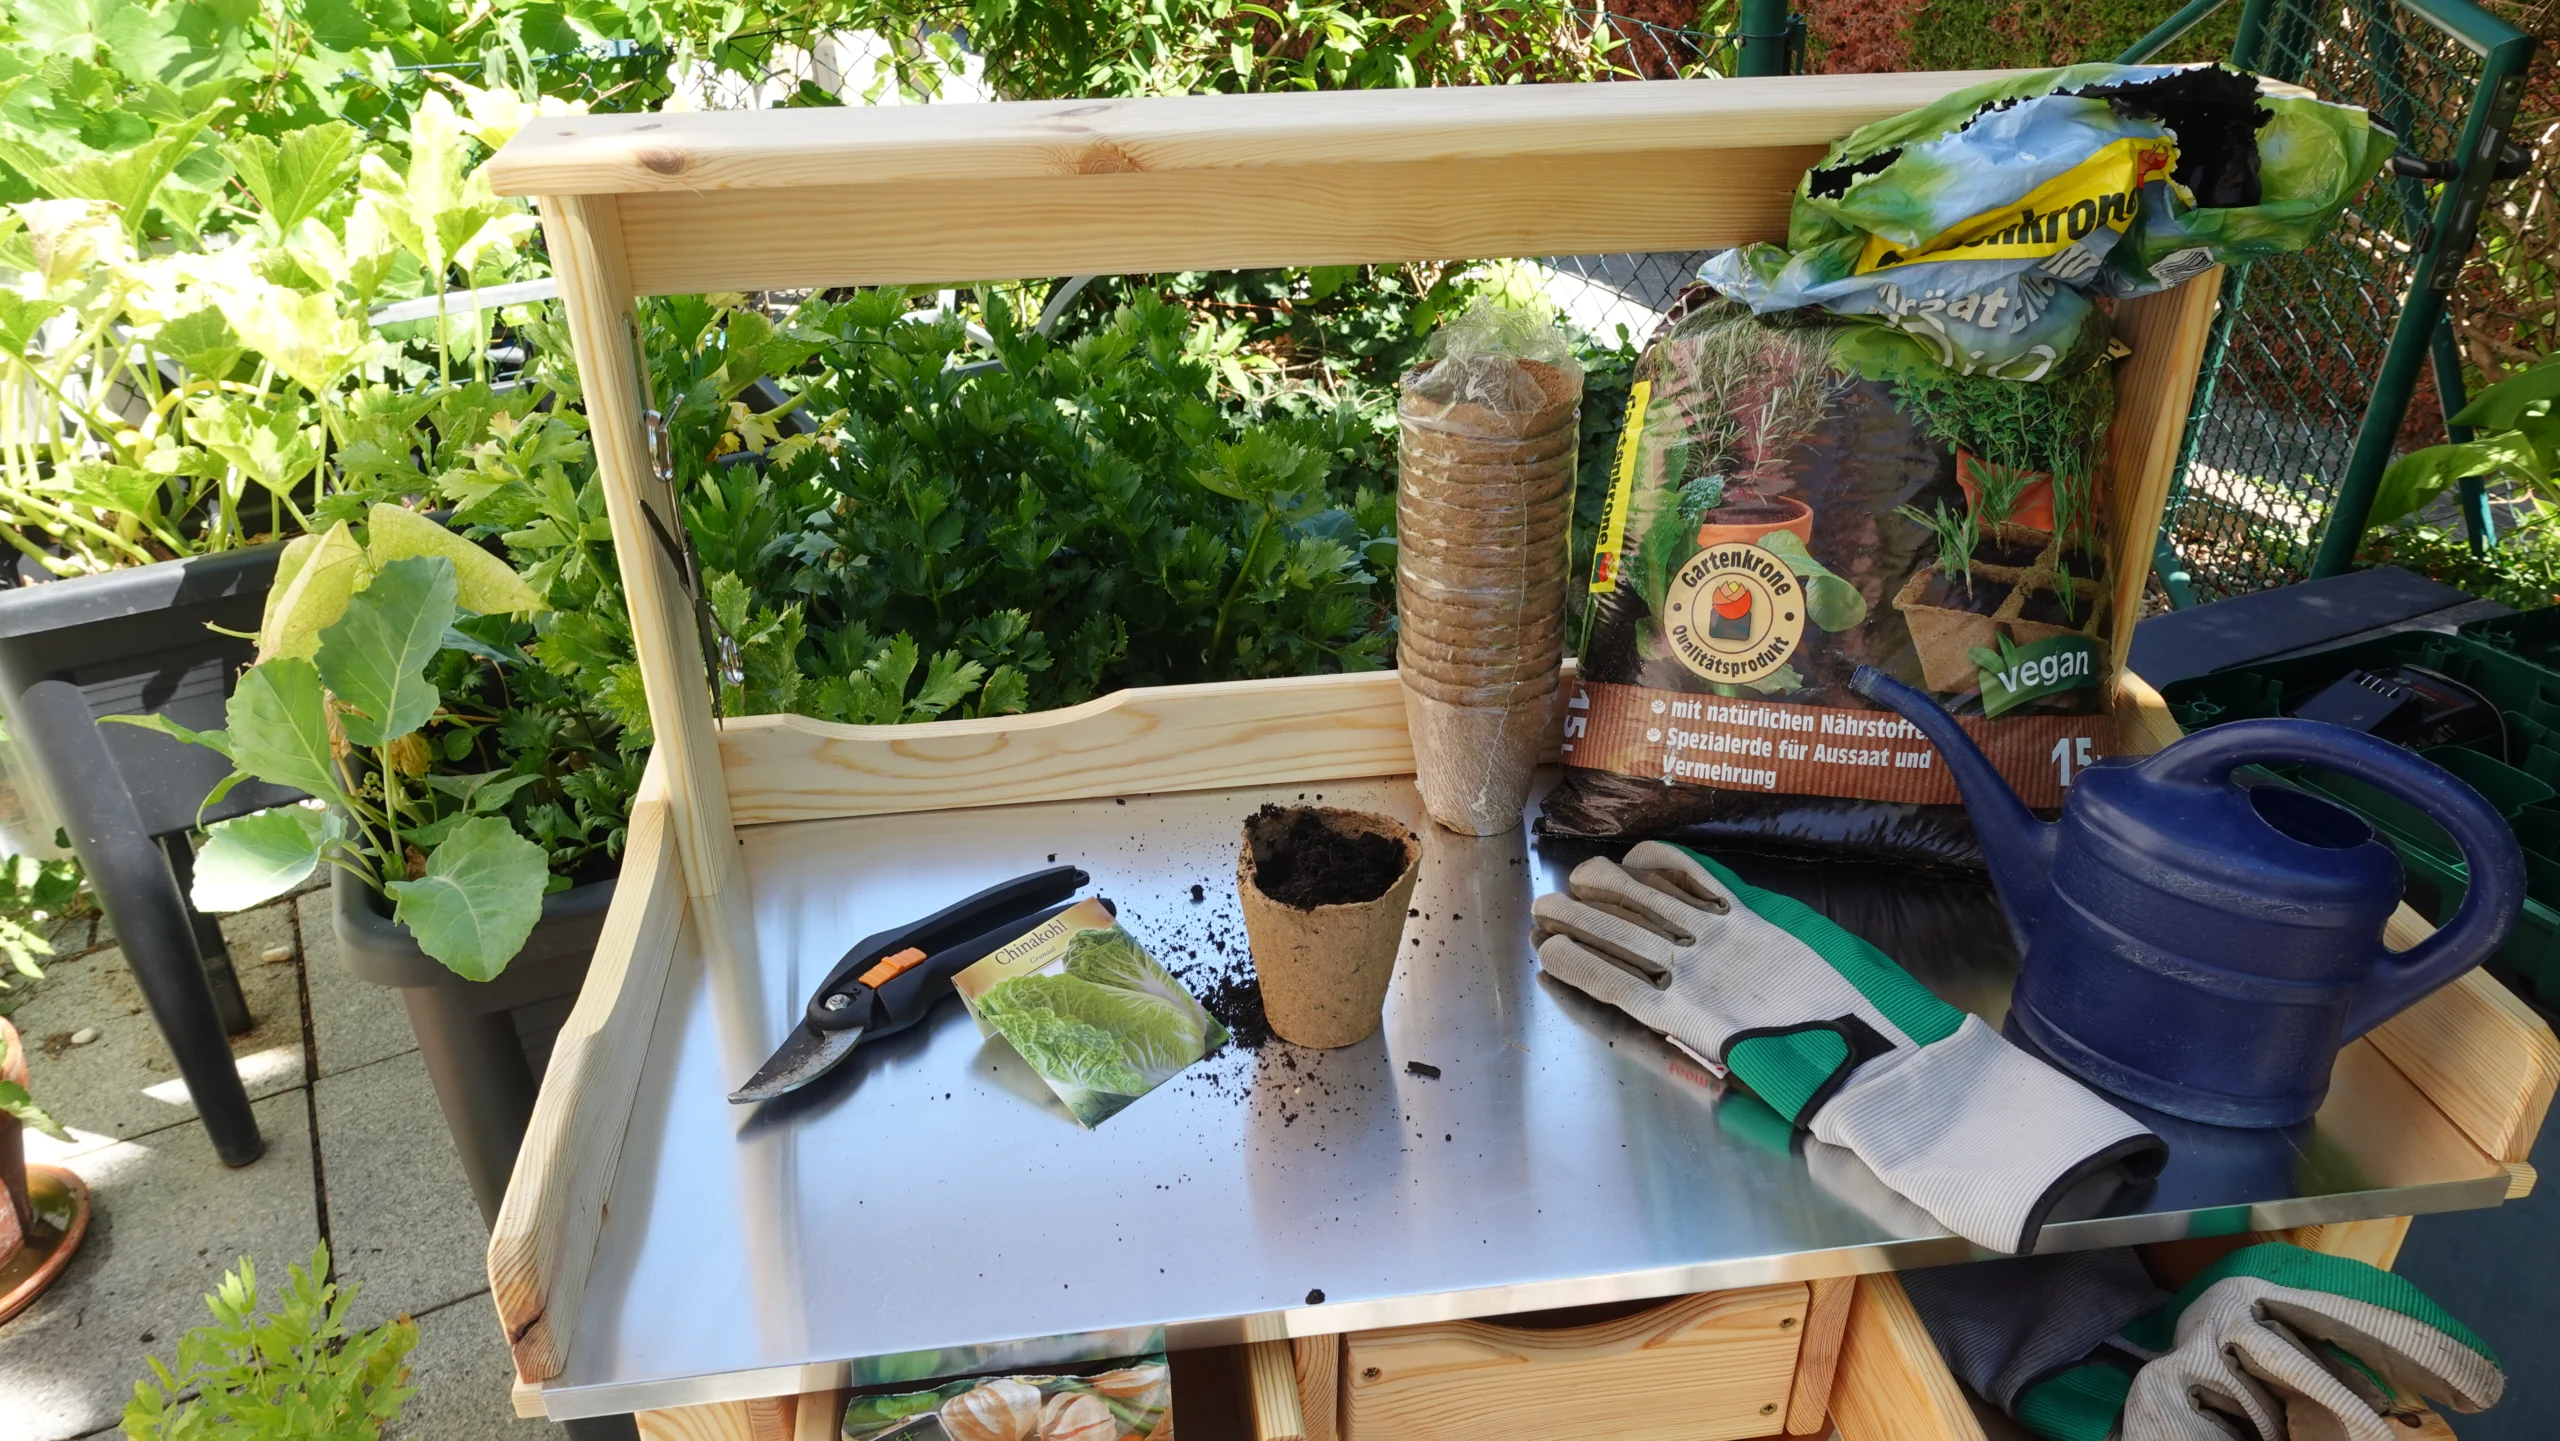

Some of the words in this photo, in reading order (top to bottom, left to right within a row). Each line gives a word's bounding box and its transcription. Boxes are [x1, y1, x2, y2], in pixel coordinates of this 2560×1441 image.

[1681, 549, 1792, 597] Gartenkrone
[1672, 624, 1790, 678] Qualitätsprodukt
[1997, 650, 2089, 694] vegan
[1563, 689, 1590, 738] 15
[1671, 699, 1702, 720] mit
[1707, 702, 1814, 732] natürlichen
[1820, 714, 1929, 740] Nährstoffe
[1666, 727, 1773, 758] Spezialerde
[1778, 739, 1809, 761] für
[1813, 743, 1889, 766] Aussaat
[1895, 749, 1932, 769] und
[1662, 754, 1777, 790] Vermehrung
[995, 919, 1068, 965] Chinakohl
[1029, 946, 1057, 964] Granaat
